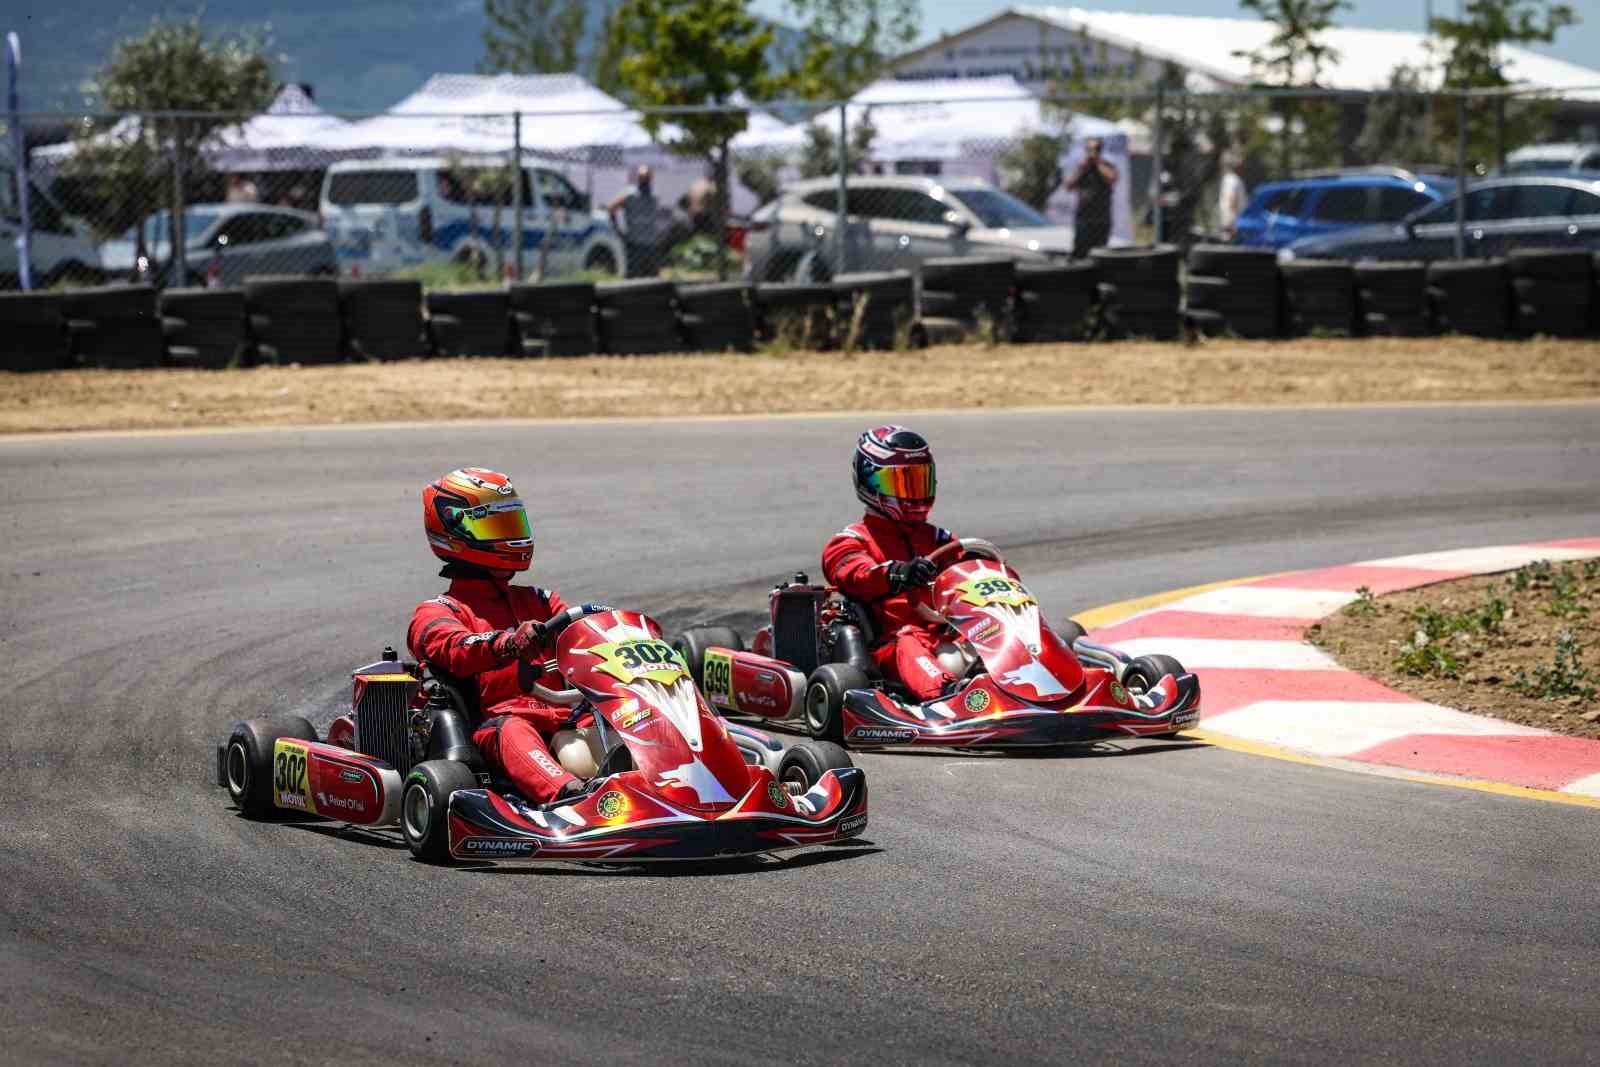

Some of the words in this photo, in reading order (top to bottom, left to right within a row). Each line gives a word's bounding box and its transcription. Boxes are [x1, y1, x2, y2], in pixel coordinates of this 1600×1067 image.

[614, 643, 682, 669] 302
[705, 661, 730, 693] 399
[857, 729, 913, 738] DYNAMIC
[275, 752, 307, 794] 302
[466, 840, 534, 850] DYNAMIC
